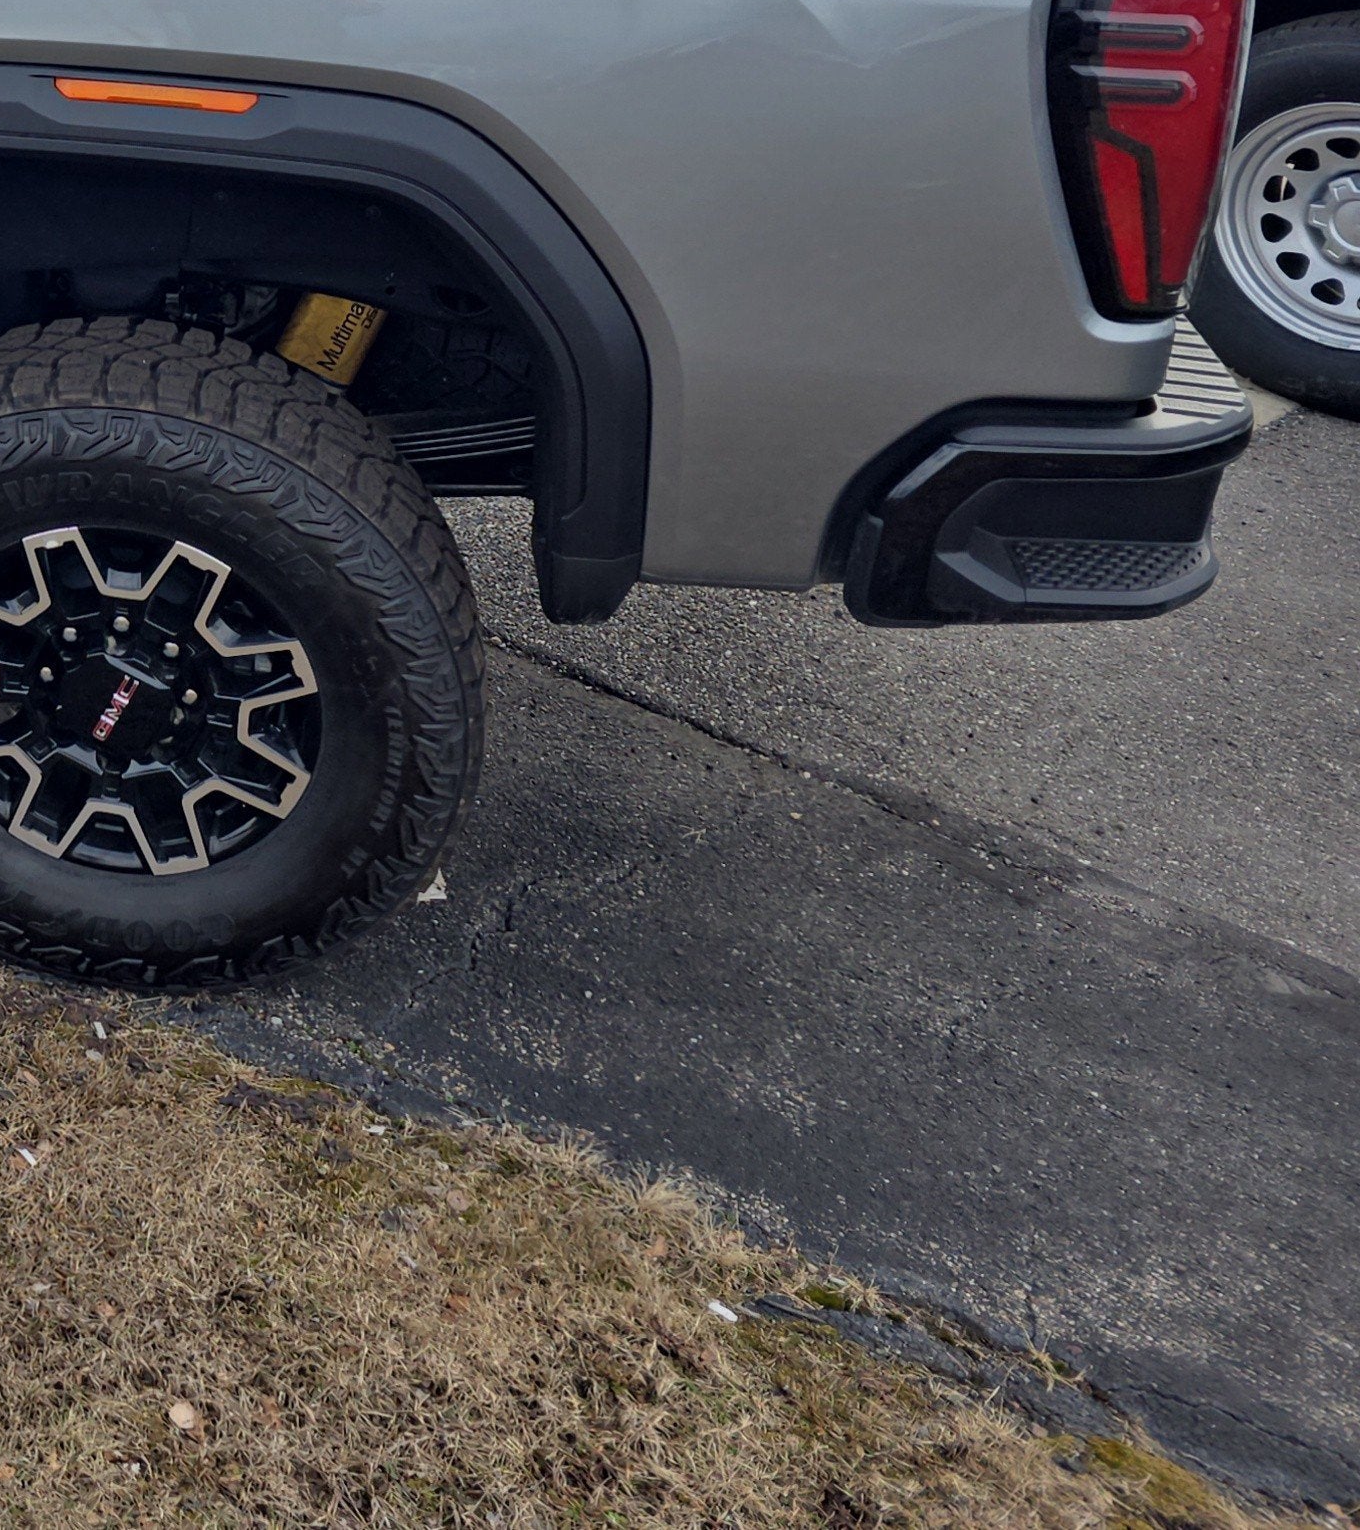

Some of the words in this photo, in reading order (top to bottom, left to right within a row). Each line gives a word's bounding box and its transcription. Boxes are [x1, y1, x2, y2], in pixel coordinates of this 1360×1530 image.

[316, 302, 366, 372] Multima
[1, 471, 325, 590] WRANGLER
[92, 674, 140, 742] GMC
